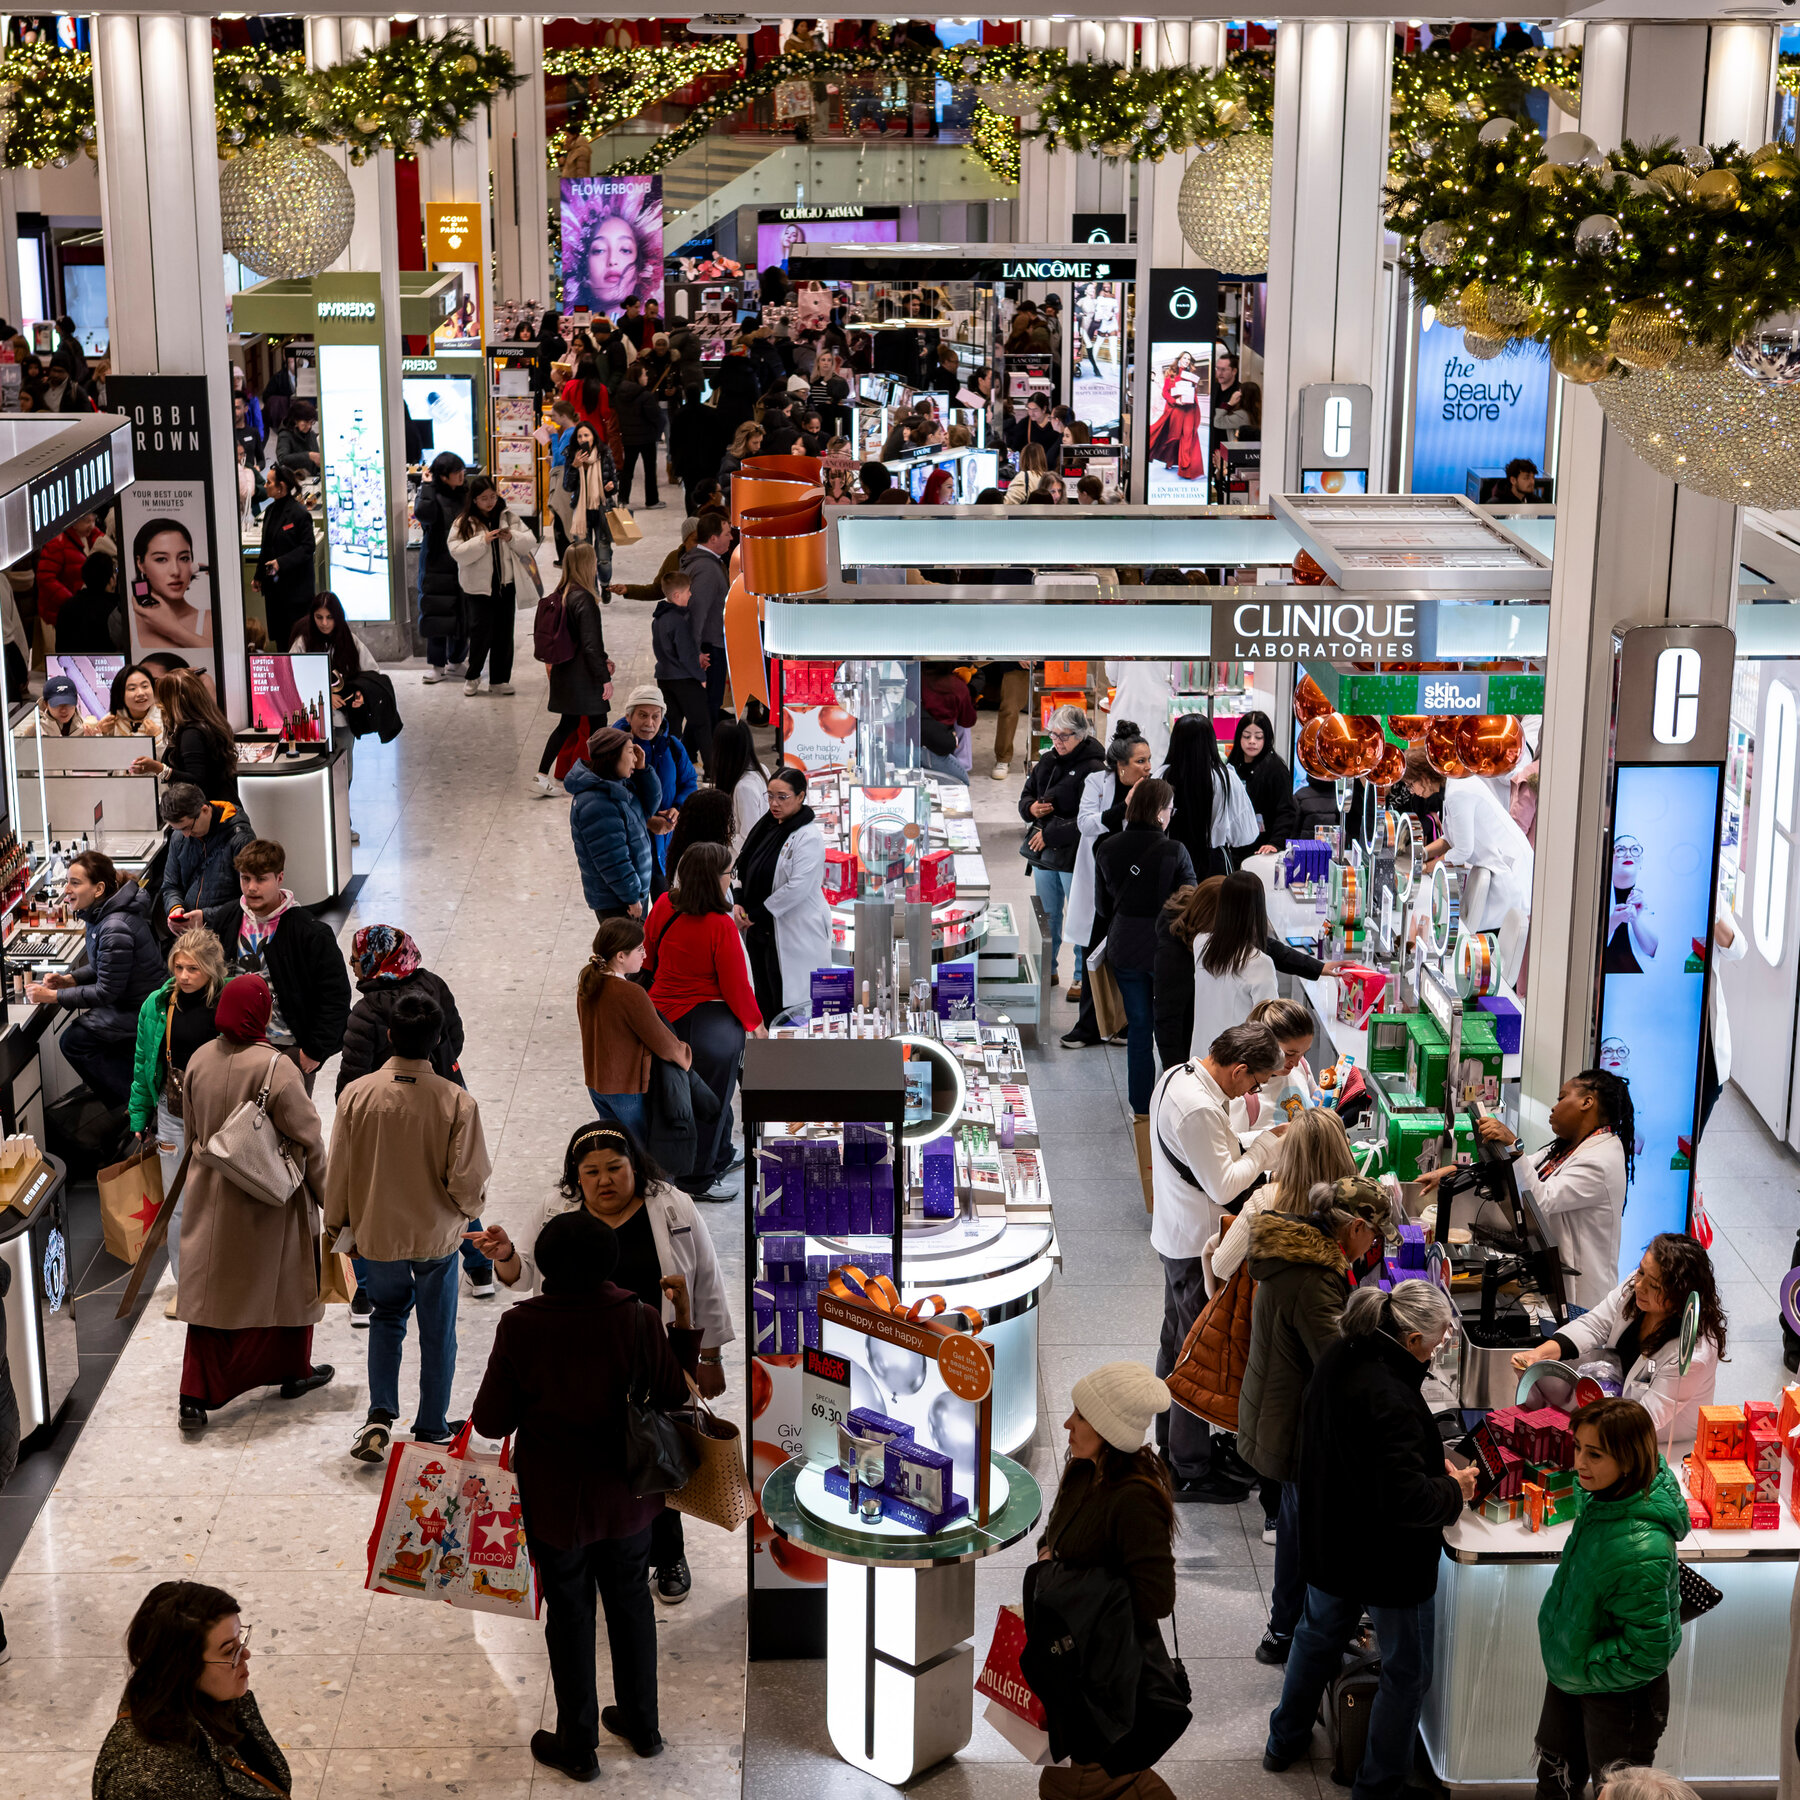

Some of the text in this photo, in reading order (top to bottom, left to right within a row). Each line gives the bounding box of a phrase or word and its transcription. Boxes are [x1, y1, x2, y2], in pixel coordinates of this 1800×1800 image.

[571, 182, 652, 196] FLOWERBOMB
[439, 215, 469, 223] ACQUA
[780, 205, 864, 220] GIORGIO ARMANI
[439, 226, 469, 234] PARMA
[683, 238, 713, 247] UGLER
[1002, 259, 1092, 279] LANCÔME
[317, 302, 376, 318] BYREDO
[401, 359, 438, 371] YREDO
[1444, 356, 1475, 378] the
[1443, 377, 1523, 407] beauty
[1442, 399, 1500, 421] store
[136, 431, 200, 451] ROWN
[33, 450, 112, 532] BOBBI BROWN
[132, 490, 193, 498] YOUR BEST LOOK
[142, 499, 184, 507] IN MINUTES
[1233, 604, 1416, 643] CLINIQUE
[1234, 643, 1414, 658] LABORATORIES
[1424, 682, 1460, 698] skin
[1424, 693, 1481, 709] school
[796, 743, 815, 752] Give
[798, 752, 816, 761] Get
[859, 804, 879, 814] Give
[824, 1302, 924, 1348] Give happy. Get happy.
[808, 1351, 844, 1371] BLACK
[952, 1351, 977, 1367] Get the
[808, 1360, 845, 1381] FRIDAY
[947, 1366, 963, 1378] best
[949, 1359, 979, 1376] season's
[815, 1393, 837, 1407] SPECIAL
[811, 1402, 842, 1423] 69.30
[777, 1424, 803, 1437] Giv
[780, 1440, 803, 1453] Ge
[426, 1525, 440, 1534] DAY
[473, 1550, 514, 1566] macy's
[980, 1666, 1033, 1710] HOLLISTER
